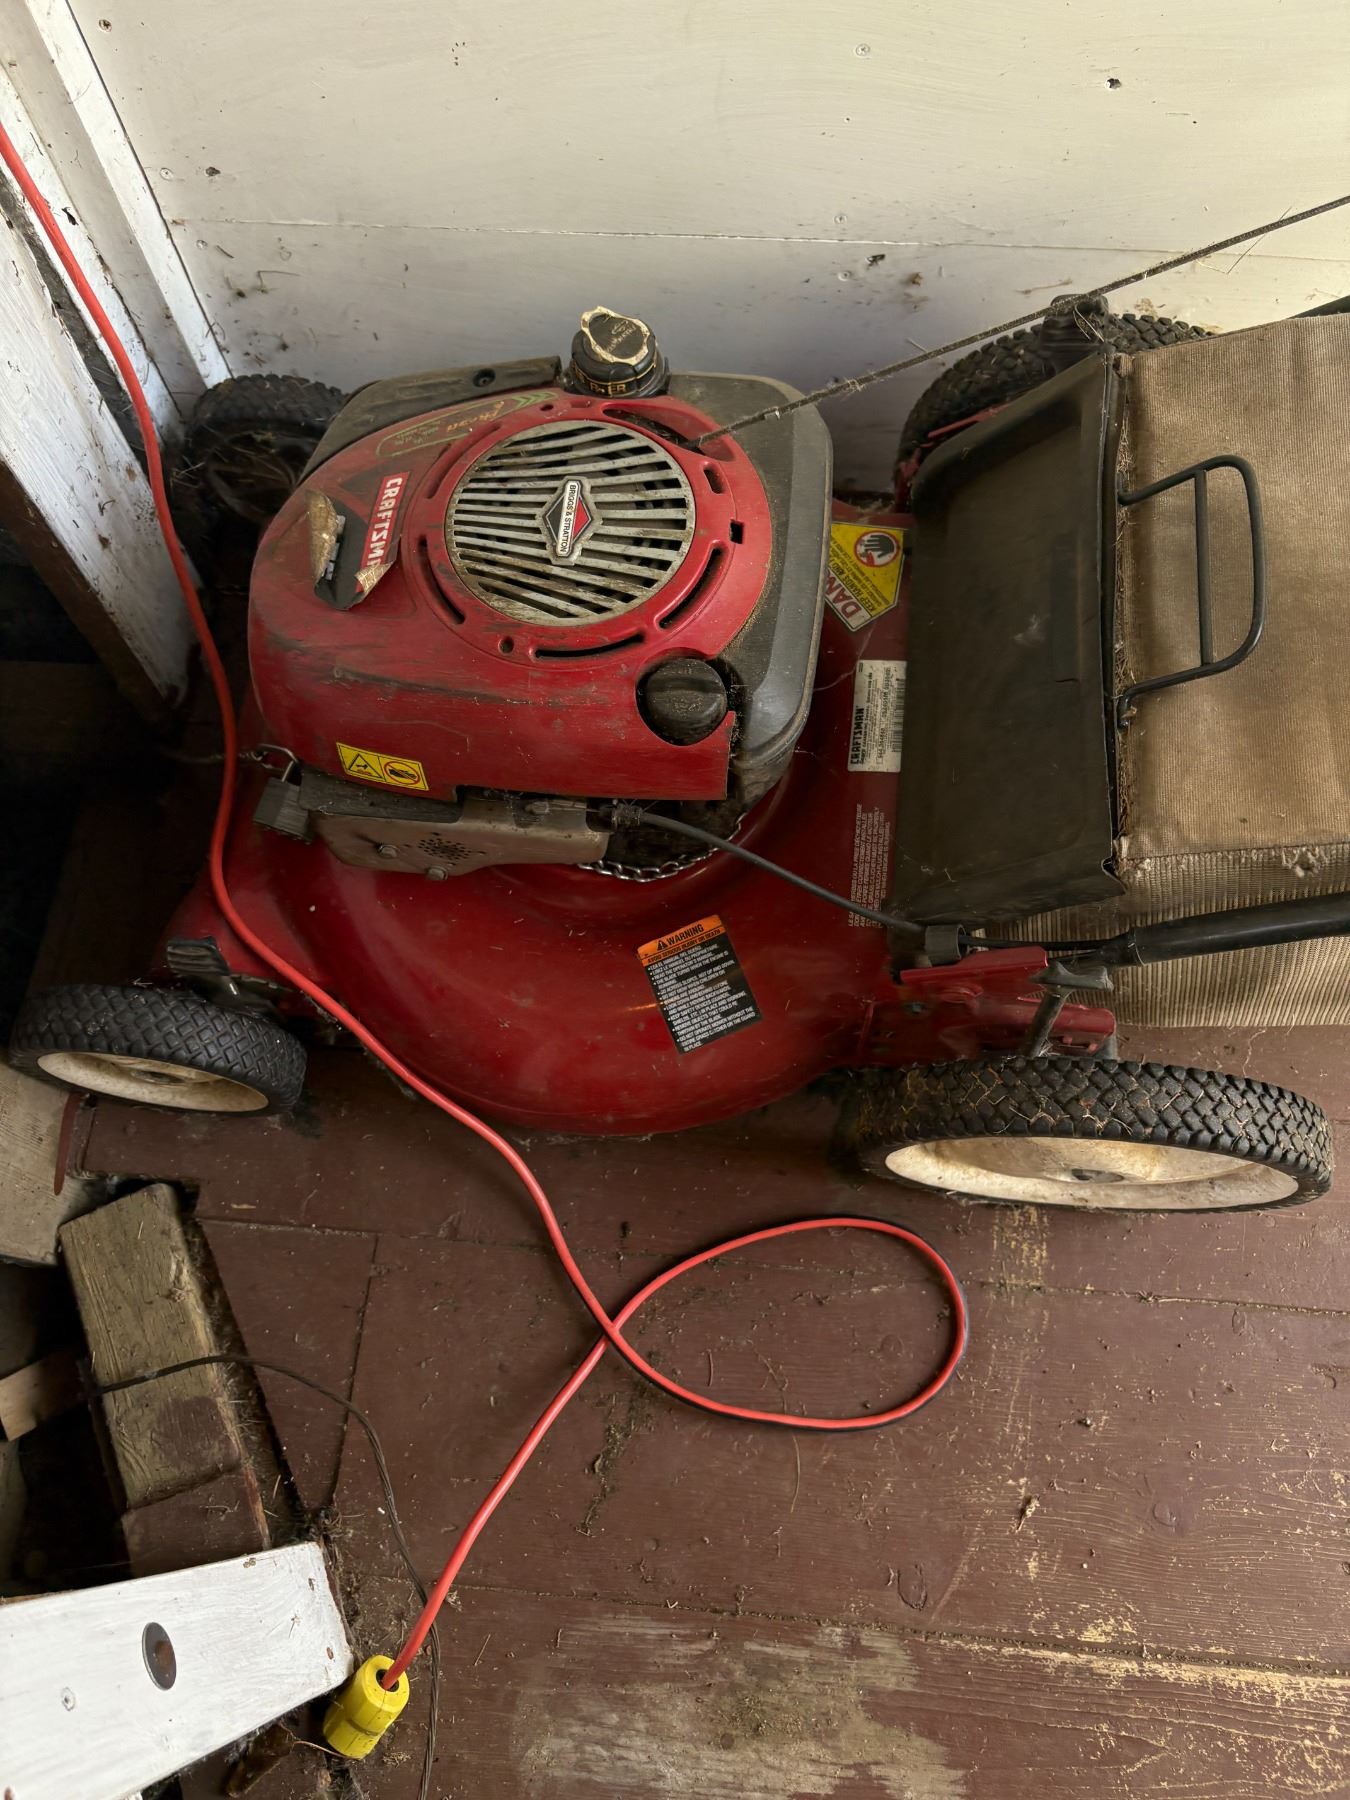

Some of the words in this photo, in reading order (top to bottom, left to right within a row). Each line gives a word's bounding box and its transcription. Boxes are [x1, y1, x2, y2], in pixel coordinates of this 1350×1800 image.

[566, 484, 577, 511] BRIGGS
[367, 476, 403, 568] CRAFTSMA
[559, 517, 571, 553] STRATTON
[825, 570, 862, 619] DAN
[841, 575, 863, 597] HANDS
[860, 596, 875, 612] KEEP
[850, 708, 863, 763] CRAFTSMAN
[662, 946, 681, 957] SERIOUS
[681, 939, 697, 948] INJURY
[705, 929, 720, 938] DEATH
[666, 923, 704, 945] WARNING
